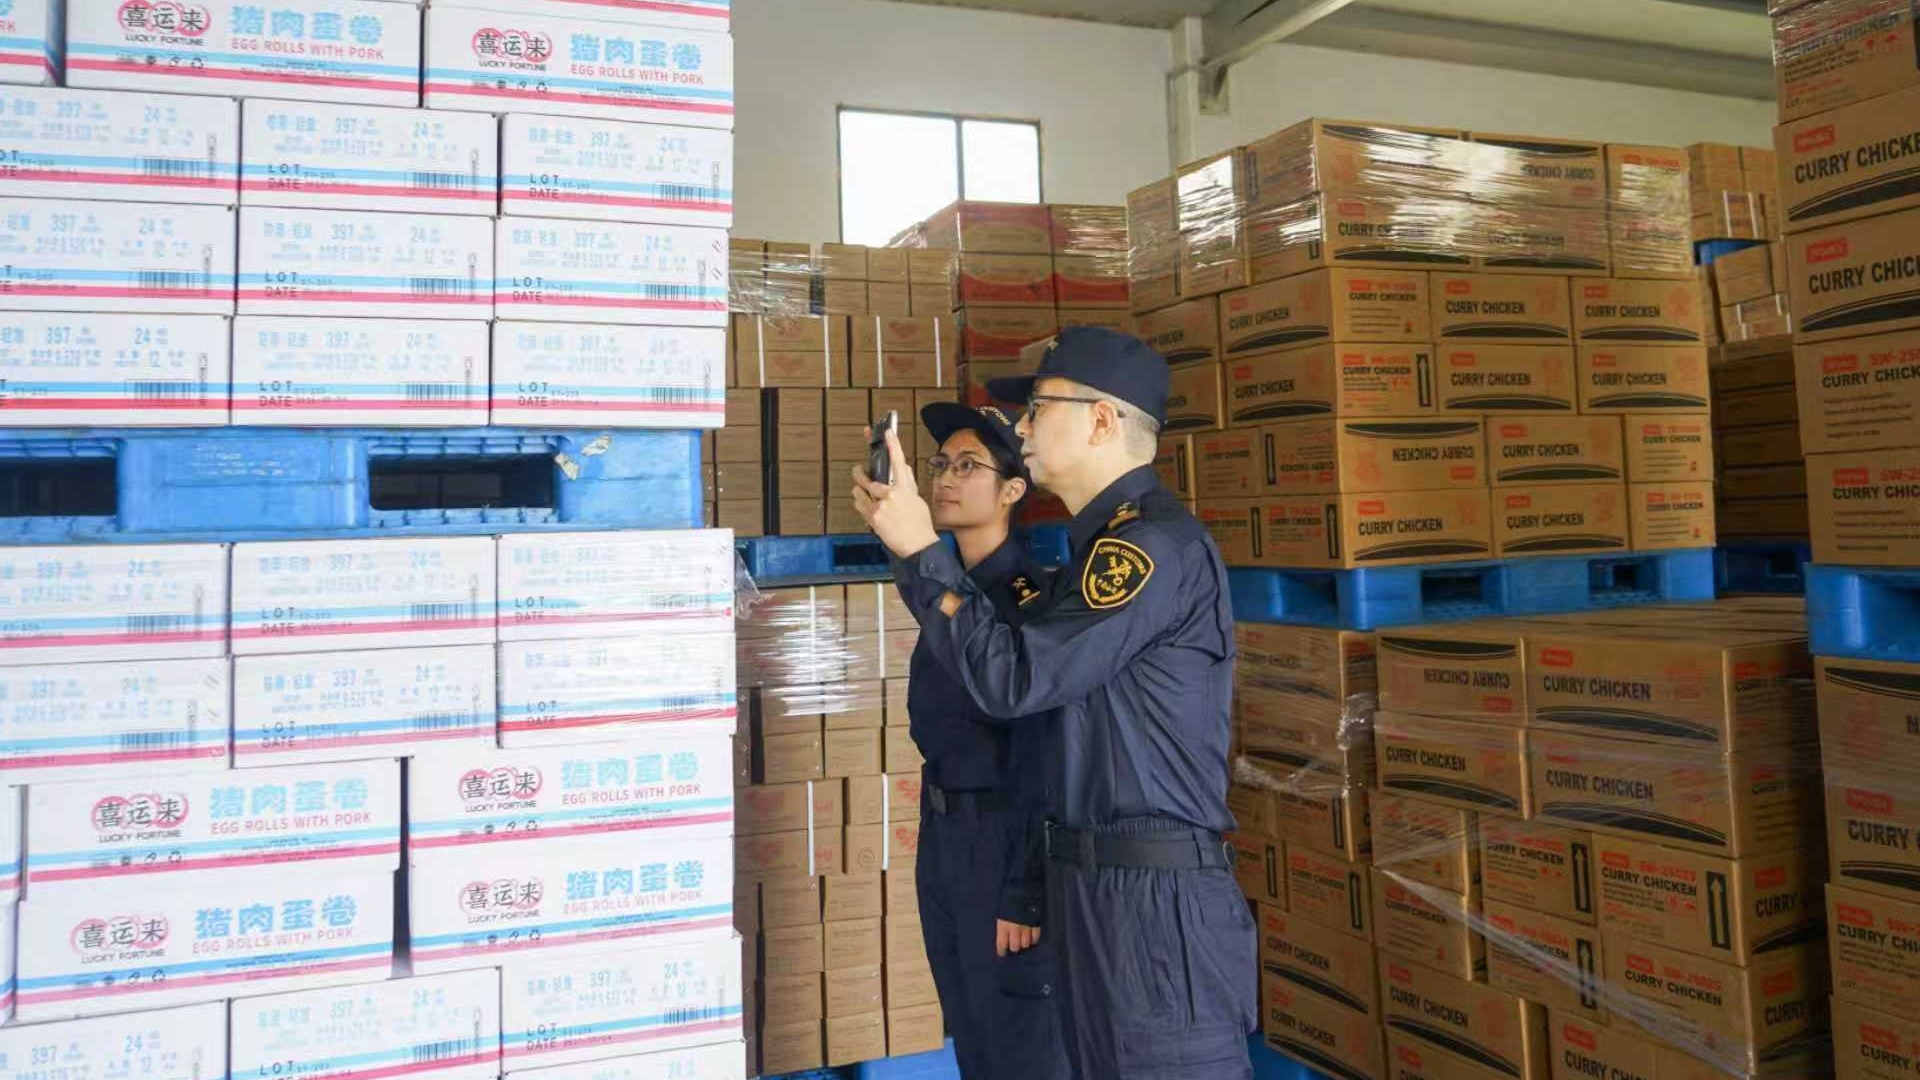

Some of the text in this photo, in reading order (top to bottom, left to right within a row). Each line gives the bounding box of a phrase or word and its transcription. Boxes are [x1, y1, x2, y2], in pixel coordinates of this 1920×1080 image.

[123, 6, 204, 31] 喜运来
[125, 34, 204, 47] LUCKY FORTUNE
[478, 30, 547, 60] 喜运来
[231, 38, 258, 51] EGG
[310, 43, 343, 57] WITH
[348, 46, 384, 61] PORK
[479, 60, 547, 72] LUCKY FORTUNE
[571, 64, 704, 85] EGG ROLLS WITH PORK
[268, 164, 301, 175] LOT
[1795, 153, 1850, 184] CURRY
[268, 178, 300, 189] DATE
[530, 174, 559, 185] LOT
[530, 187, 558, 199] DATE
[1338, 221, 1374, 236] CURRY
[265, 272, 297, 283] LOT
[512, 277, 542, 288] LOT
[1809, 267, 1865, 294] CURRY
[265, 286, 296, 298] DATE
[512, 291, 542, 302] DATE
[1349, 292, 1377, 300] CURRY
[1446, 302, 1525, 314] CURRY CHICKEN
[1585, 306, 1660, 317] CURRY CHICKEN
[1229, 308, 1290, 330] CURRY CHICKEN
[135, 329, 150, 345] 24
[259, 381, 293, 392] LOT
[1451, 373, 1530, 385] CURRY CHICKEN
[1592, 373, 1666, 385] CURRY CHICKEN
[1822, 372, 1869, 388] CURRY
[518, 382, 548, 393] LOT
[1234, 380, 1296, 399] CURRY CHICKEN
[259, 395, 292, 407] DATE
[518, 396, 548, 407] DATE
[1392, 447, 1474, 461] CURRY CHICKEN
[1503, 444, 1579, 458] CURRY CHICKEN
[1833, 486, 1879, 500] CURRY
[1673, 502, 1703, 510] CHICKEN
[1359, 518, 1443, 535] CURRY CHICKEN
[1507, 514, 1584, 529] CURRY CHICKEN
[1097, 546, 1146, 574] CHINA CUSTOMS
[515, 596, 545, 607] LOT
[262, 607, 295, 619] LOT
[515, 612, 545, 621] DATE
[262, 622, 295, 634] DATE
[333, 670, 356, 687] 397
[1424, 668, 1510, 688] CURRY CHICKEN
[1544, 676, 1651, 700] CURRY CHICKEN
[527, 701, 557, 712] LOT
[262, 721, 296, 733] LOT
[262, 737, 295, 749] DATE
[1386, 747, 1466, 772] CURRY CHICKEN
[463, 771, 538, 799] 喜运来
[1546, 770, 1654, 800] CURRY CHICKEN
[562, 784, 700, 806] EGG ROLLS WITH PORK
[98, 798, 185, 828] 喜运来
[465, 800, 537, 813] LUCKY FORTUNE
[211, 812, 371, 835] EGG ROLLS WITH PORK
[99, 829, 182, 844] LUCKY FORTUNE
[1848, 820, 1908, 849] CURRY
[1520, 847, 1564, 865] CHICKEN
[1602, 867, 1697, 895] CURRY CHICKEN
[465, 882, 540, 909] 喜运来
[563, 903, 588, 916] EGG
[635, 894, 665, 908] WITH
[670, 890, 702, 904] PORK
[1756, 893, 1797, 918] CURRY
[468, 910, 540, 924] LUCKY FORTUNE
[1412, 908, 1448, 924] CHICKEN
[79, 919, 167, 950] 喜运来
[193, 940, 220, 955] EGG
[276, 932, 311, 947] WITH
[318, 928, 353, 941] PORK
[1838, 924, 1887, 946] CURRY
[81, 949, 165, 965] LUCKY FORTUNE
[1295, 947, 1330, 970] CHICKEN
[664, 962, 677, 978] 24
[590, 971, 611, 988] 397
[1625, 970, 1722, 1006] CURRY CHICKEN
[1390, 988, 1468, 1027] CURRY CHICKEN
[527, 1023, 558, 1036] LOT
[1299, 1020, 1336, 1047] CHICKEN
[126, 1035, 142, 1052] 24
[527, 1039, 556, 1050] DATE
[32, 1047, 57, 1065] 397
[1565, 1051, 1607, 1077] CURRY
[1861, 1044, 1909, 1069] CURRY
